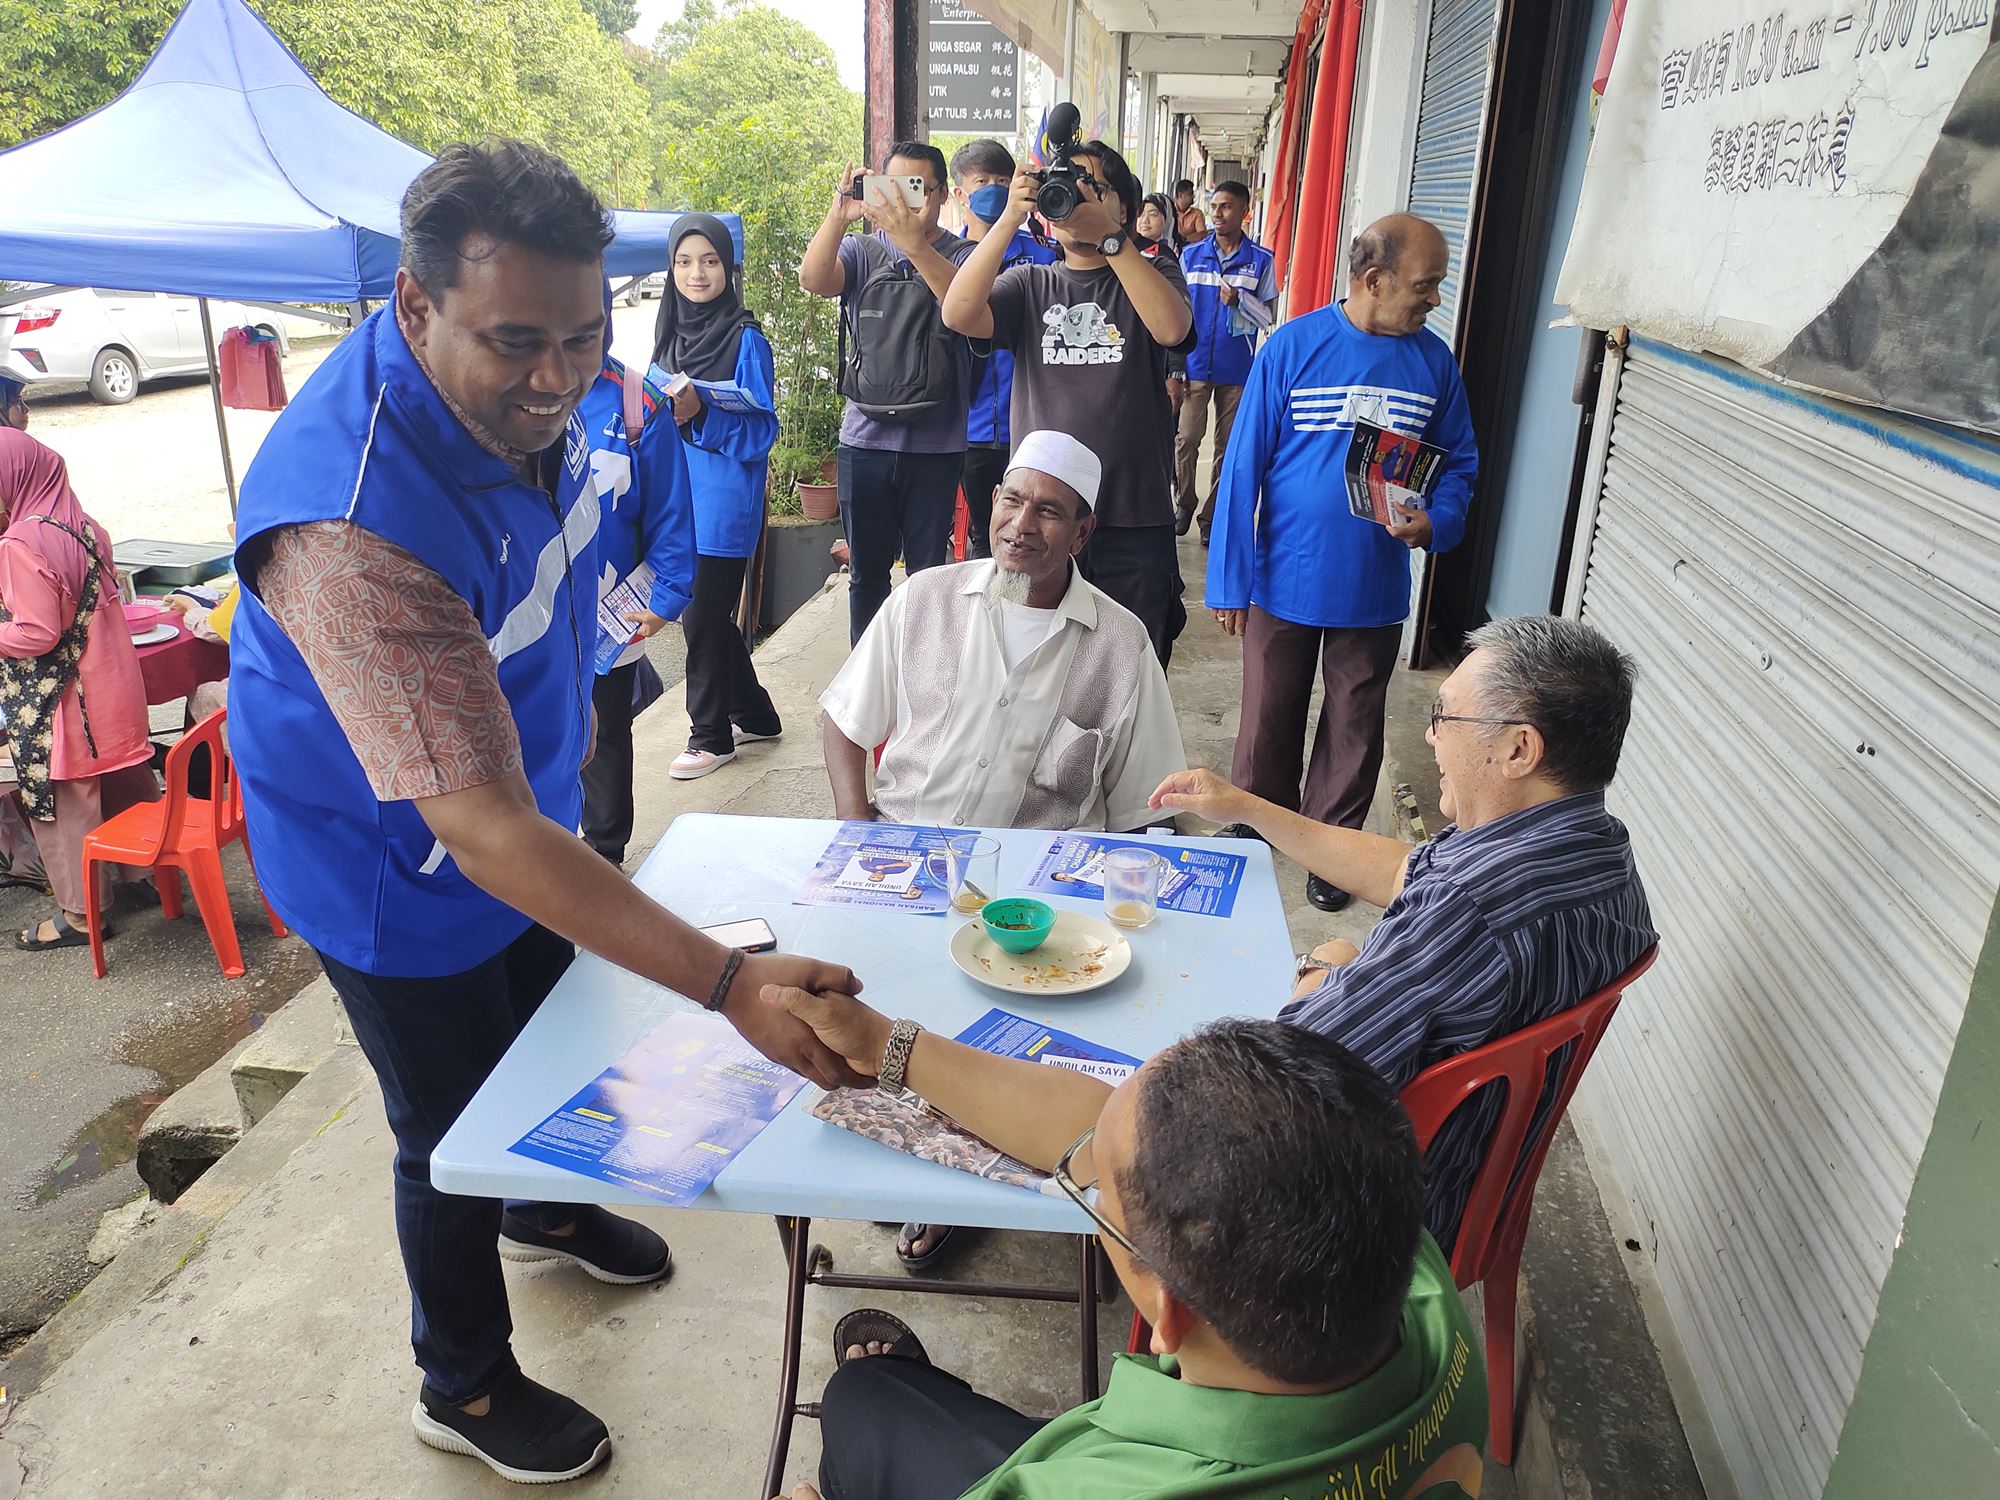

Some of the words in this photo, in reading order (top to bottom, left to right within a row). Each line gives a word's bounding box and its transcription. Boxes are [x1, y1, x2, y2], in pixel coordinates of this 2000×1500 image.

[929, 41, 953, 52] UNGA
[953, 41, 982, 52] SEGAR
[929, 64, 952, 75] UNGA
[953, 64, 979, 75] PALSU
[929, 85, 948, 96] UTIK
[928, 107, 943, 118] LAT
[944, 107, 967, 118] TULIS
[1042, 346, 1123, 365] RAIDERS
[865, 882, 902, 890] UNDILAH
[898, 903, 936, 912] BARISAN
[717, 1053, 791, 1077] CHANDRAN
[1050, 1059, 1095, 1075] UNDILAH
[1098, 1065, 1127, 1078] SAYA
